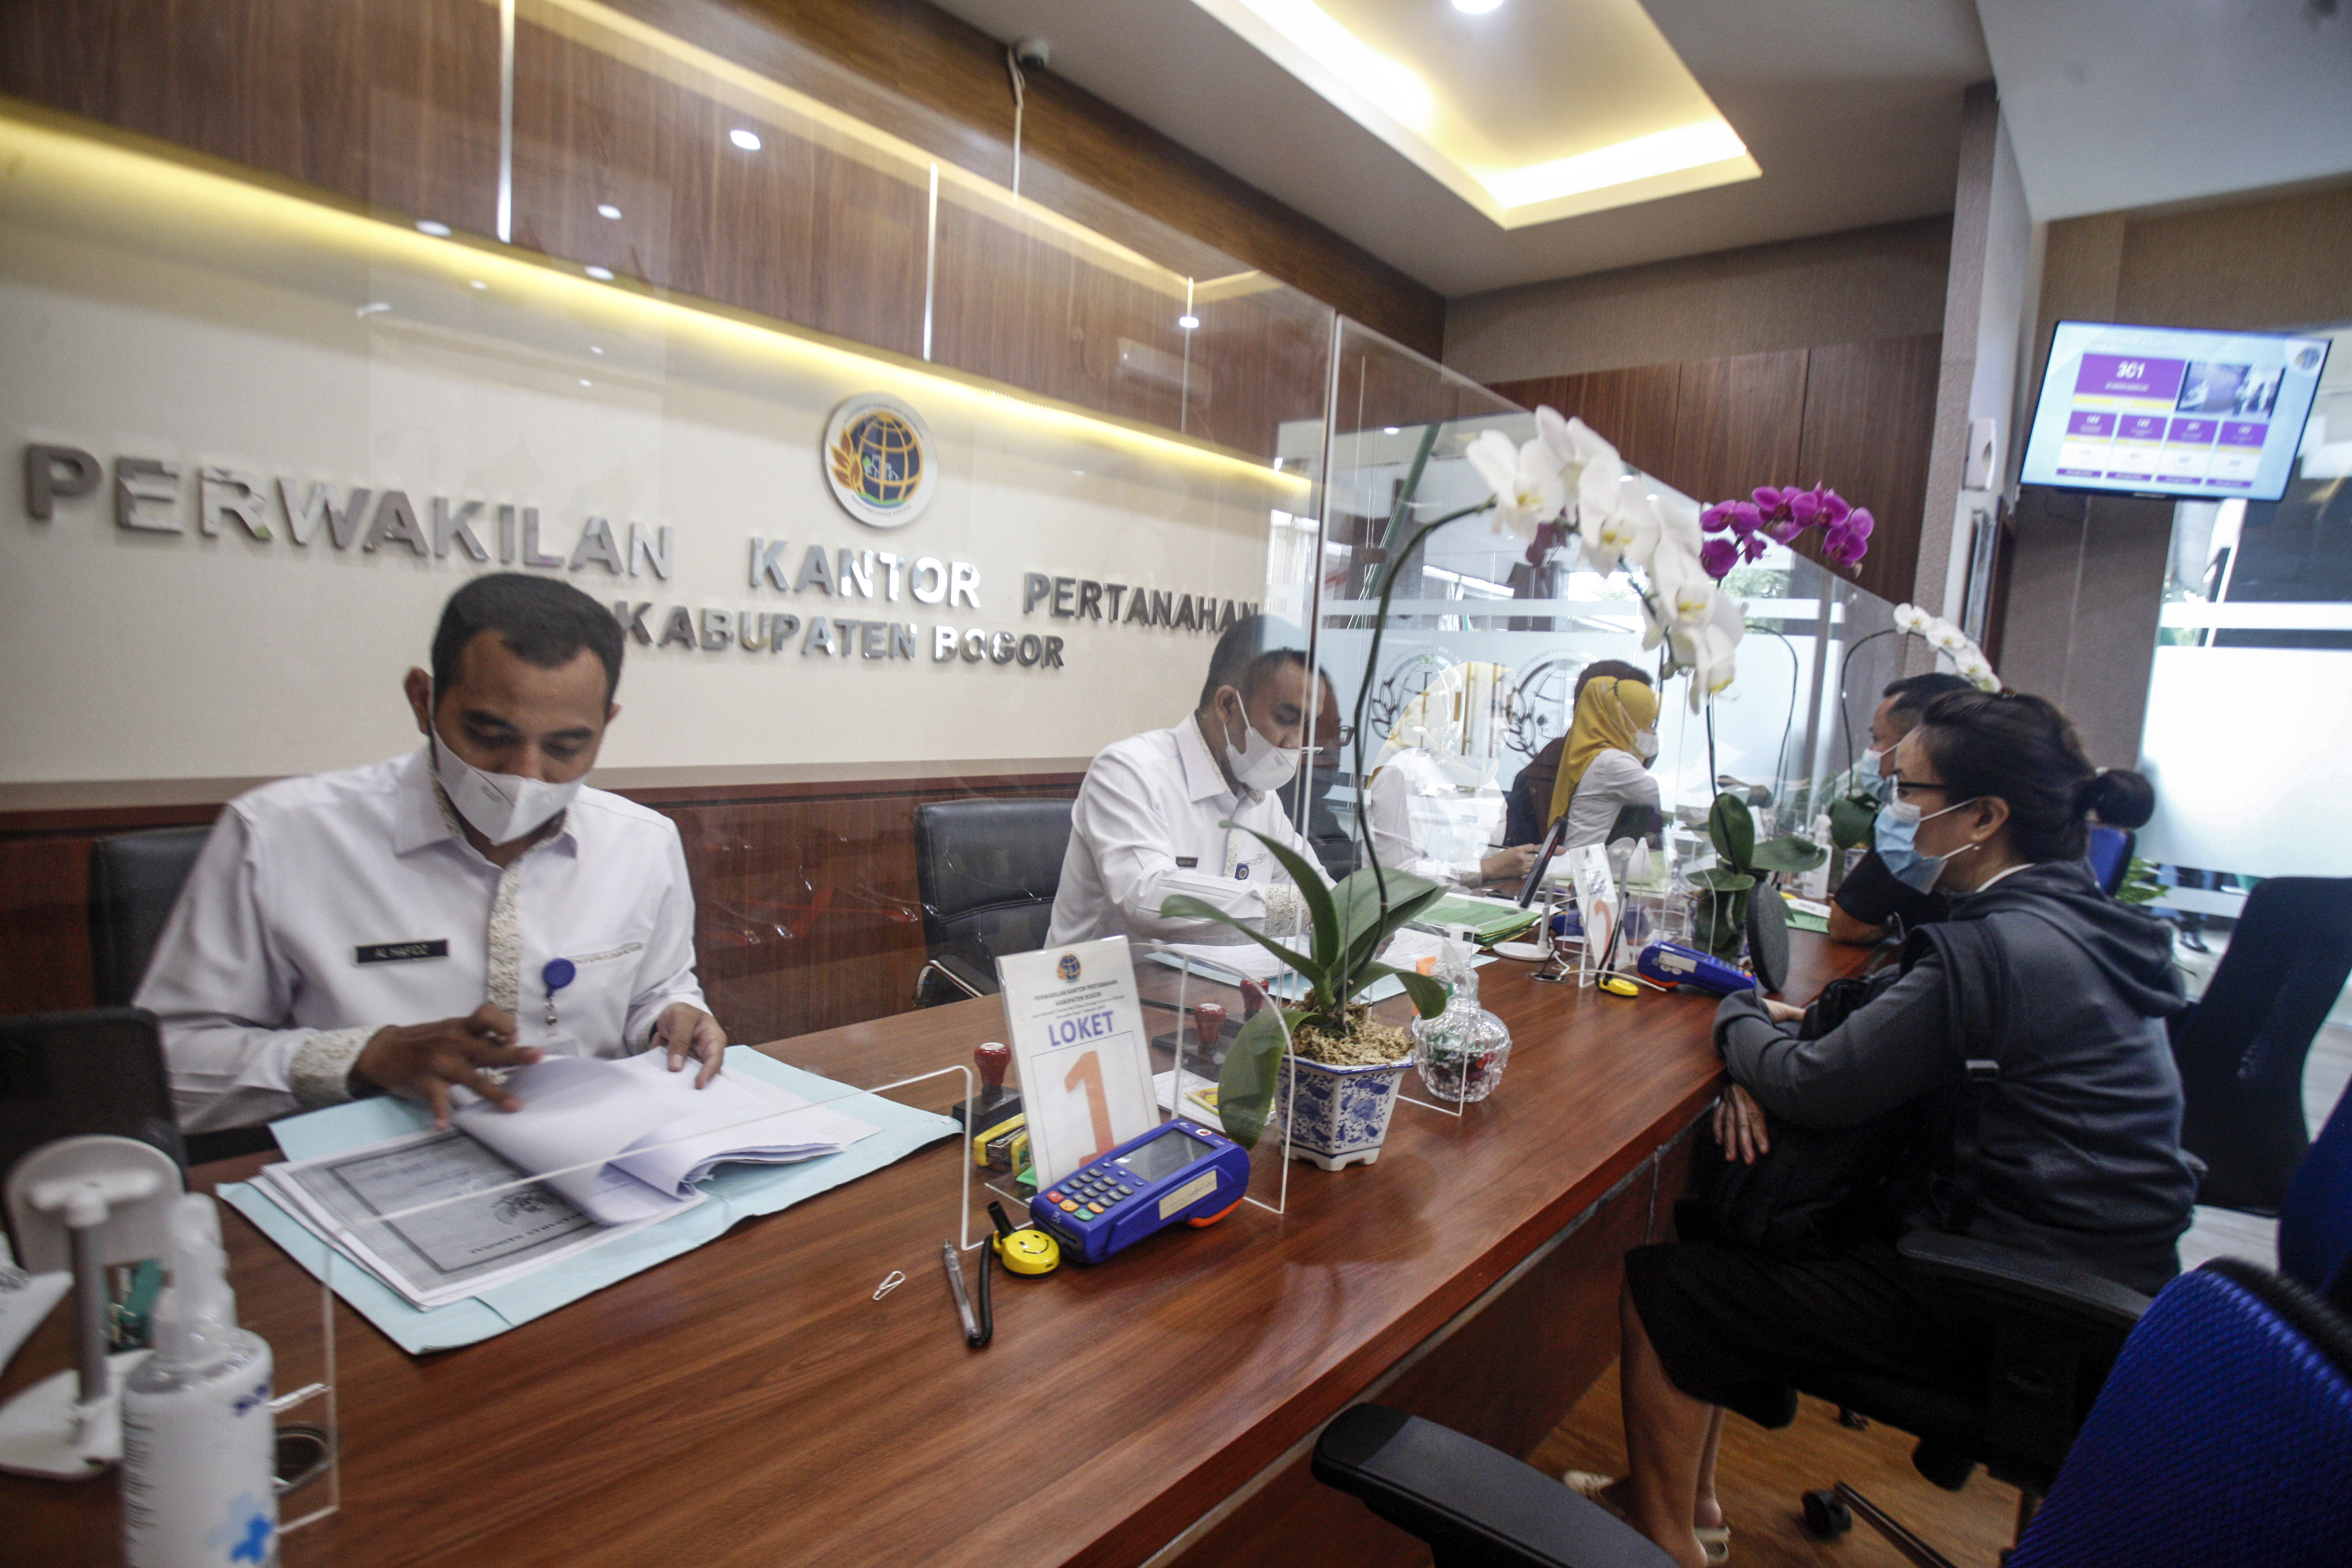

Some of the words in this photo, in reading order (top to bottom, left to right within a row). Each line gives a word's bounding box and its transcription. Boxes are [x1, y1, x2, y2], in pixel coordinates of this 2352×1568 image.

[24, 441, 674, 579] PERWAKILAN
[749, 537, 981, 608] KANTOR
[613, 600, 917, 659] KABUPATEN
[932, 624, 1064, 668] BOGOR
[1047, 1010, 1114, 1046] LOKET
[1064, 1050, 1126, 1169] 1
